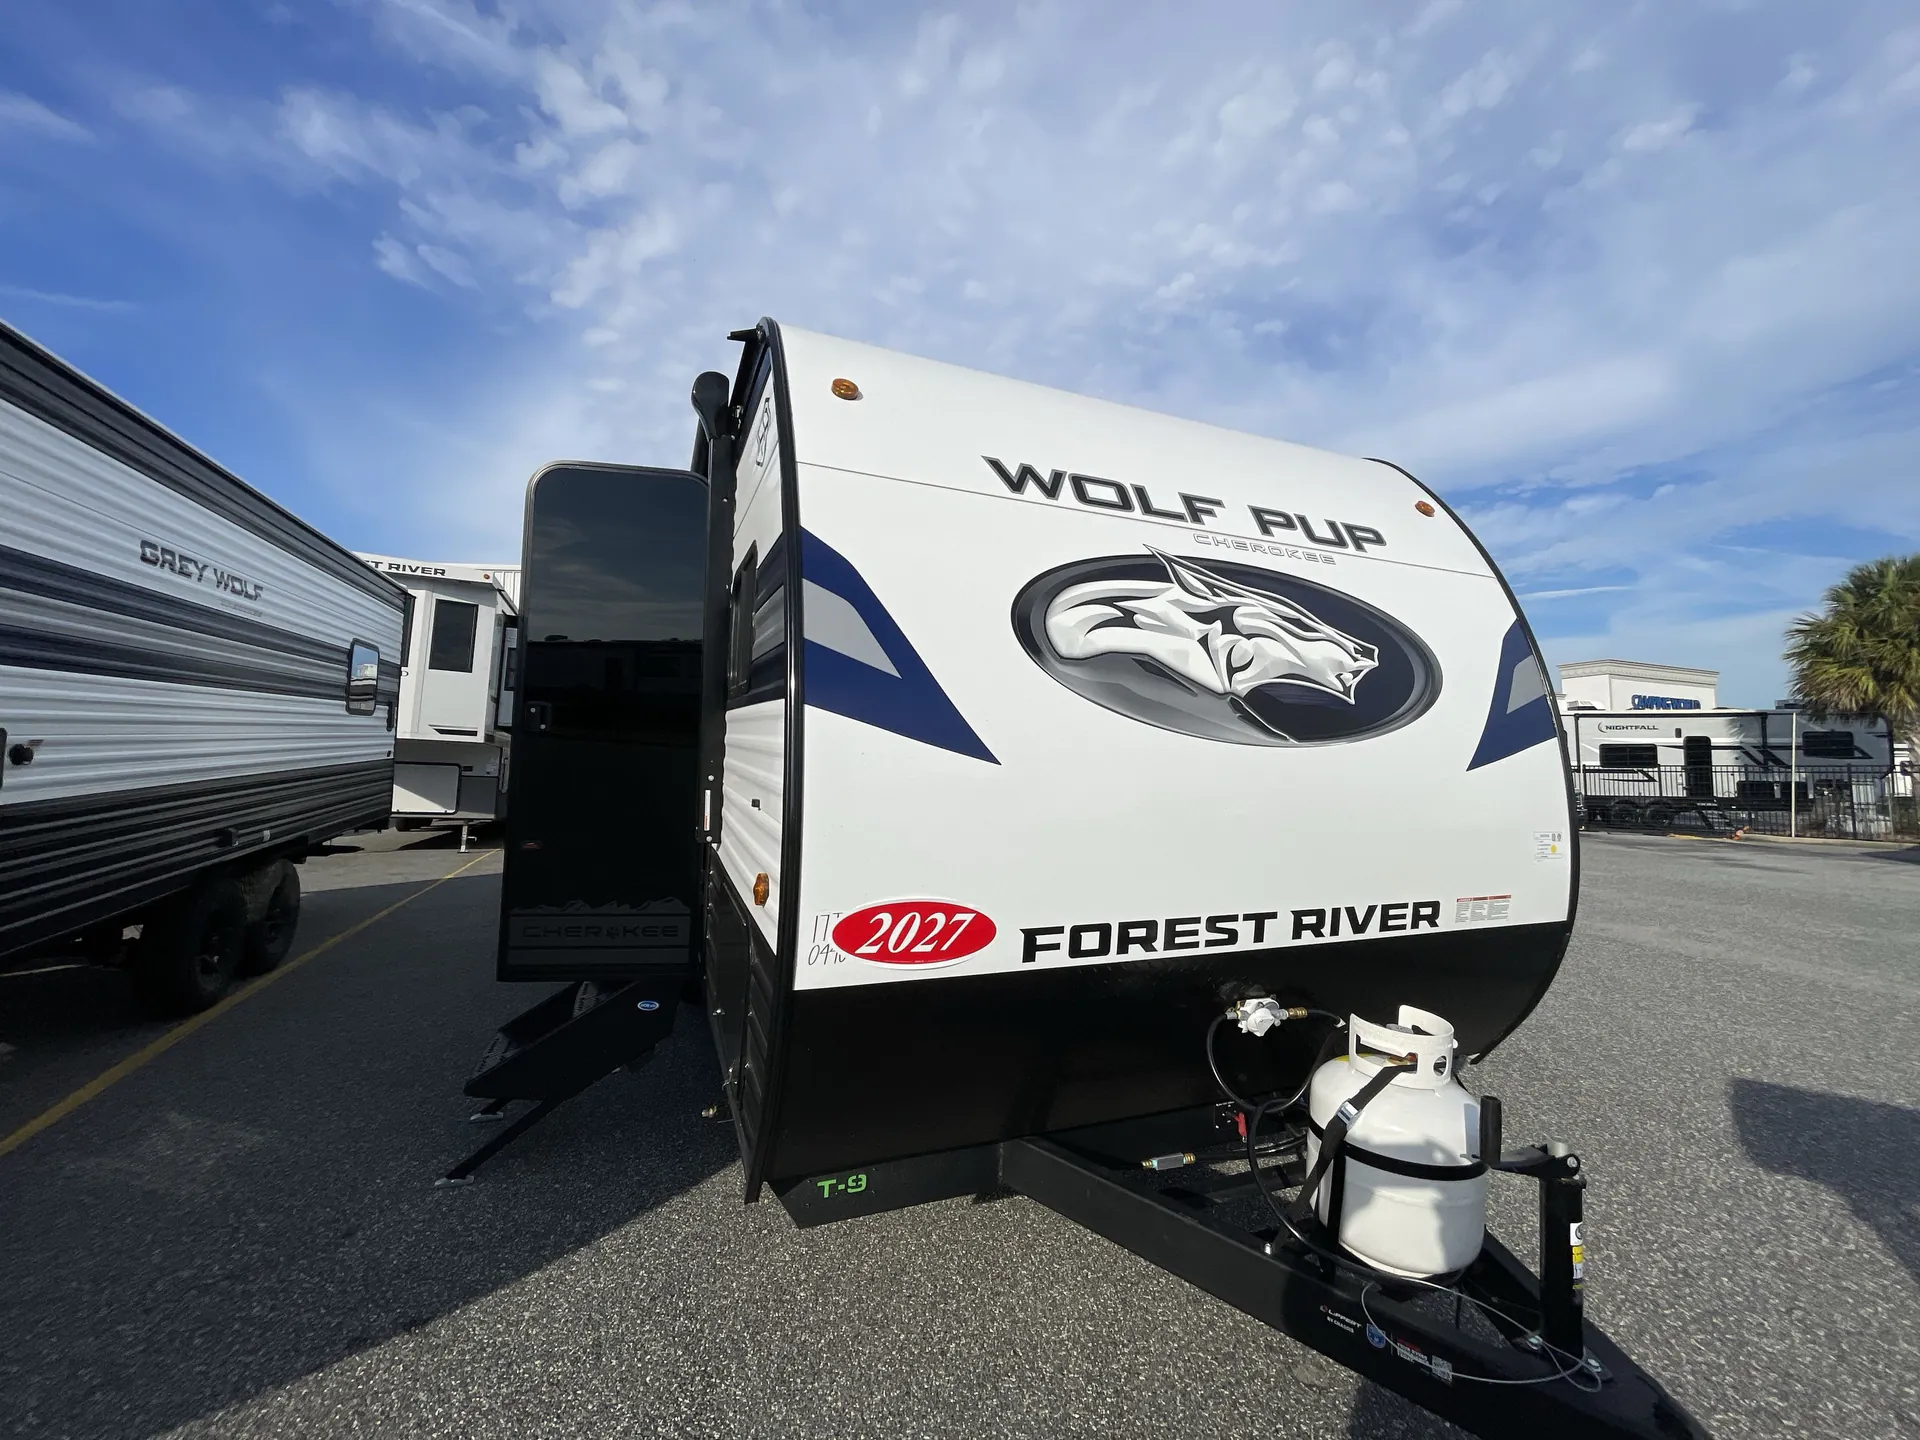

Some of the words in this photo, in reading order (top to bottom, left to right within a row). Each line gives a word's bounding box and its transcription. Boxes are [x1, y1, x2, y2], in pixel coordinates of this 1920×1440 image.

[981, 455, 1226, 526] WOLF
[1247, 505, 1387, 553] PUP
[388, 562, 446, 577] RIVER
[1192, 532, 1337, 565] CHEROKEE
[140, 539, 208, 582] GREY
[213, 567, 263, 601] WOLF
[854, 912, 977, 954] 2027
[1019, 911, 1279, 964] FOREST
[1290, 900, 1441, 940] RIVER
[817, 1174, 867, 1199] T-9
